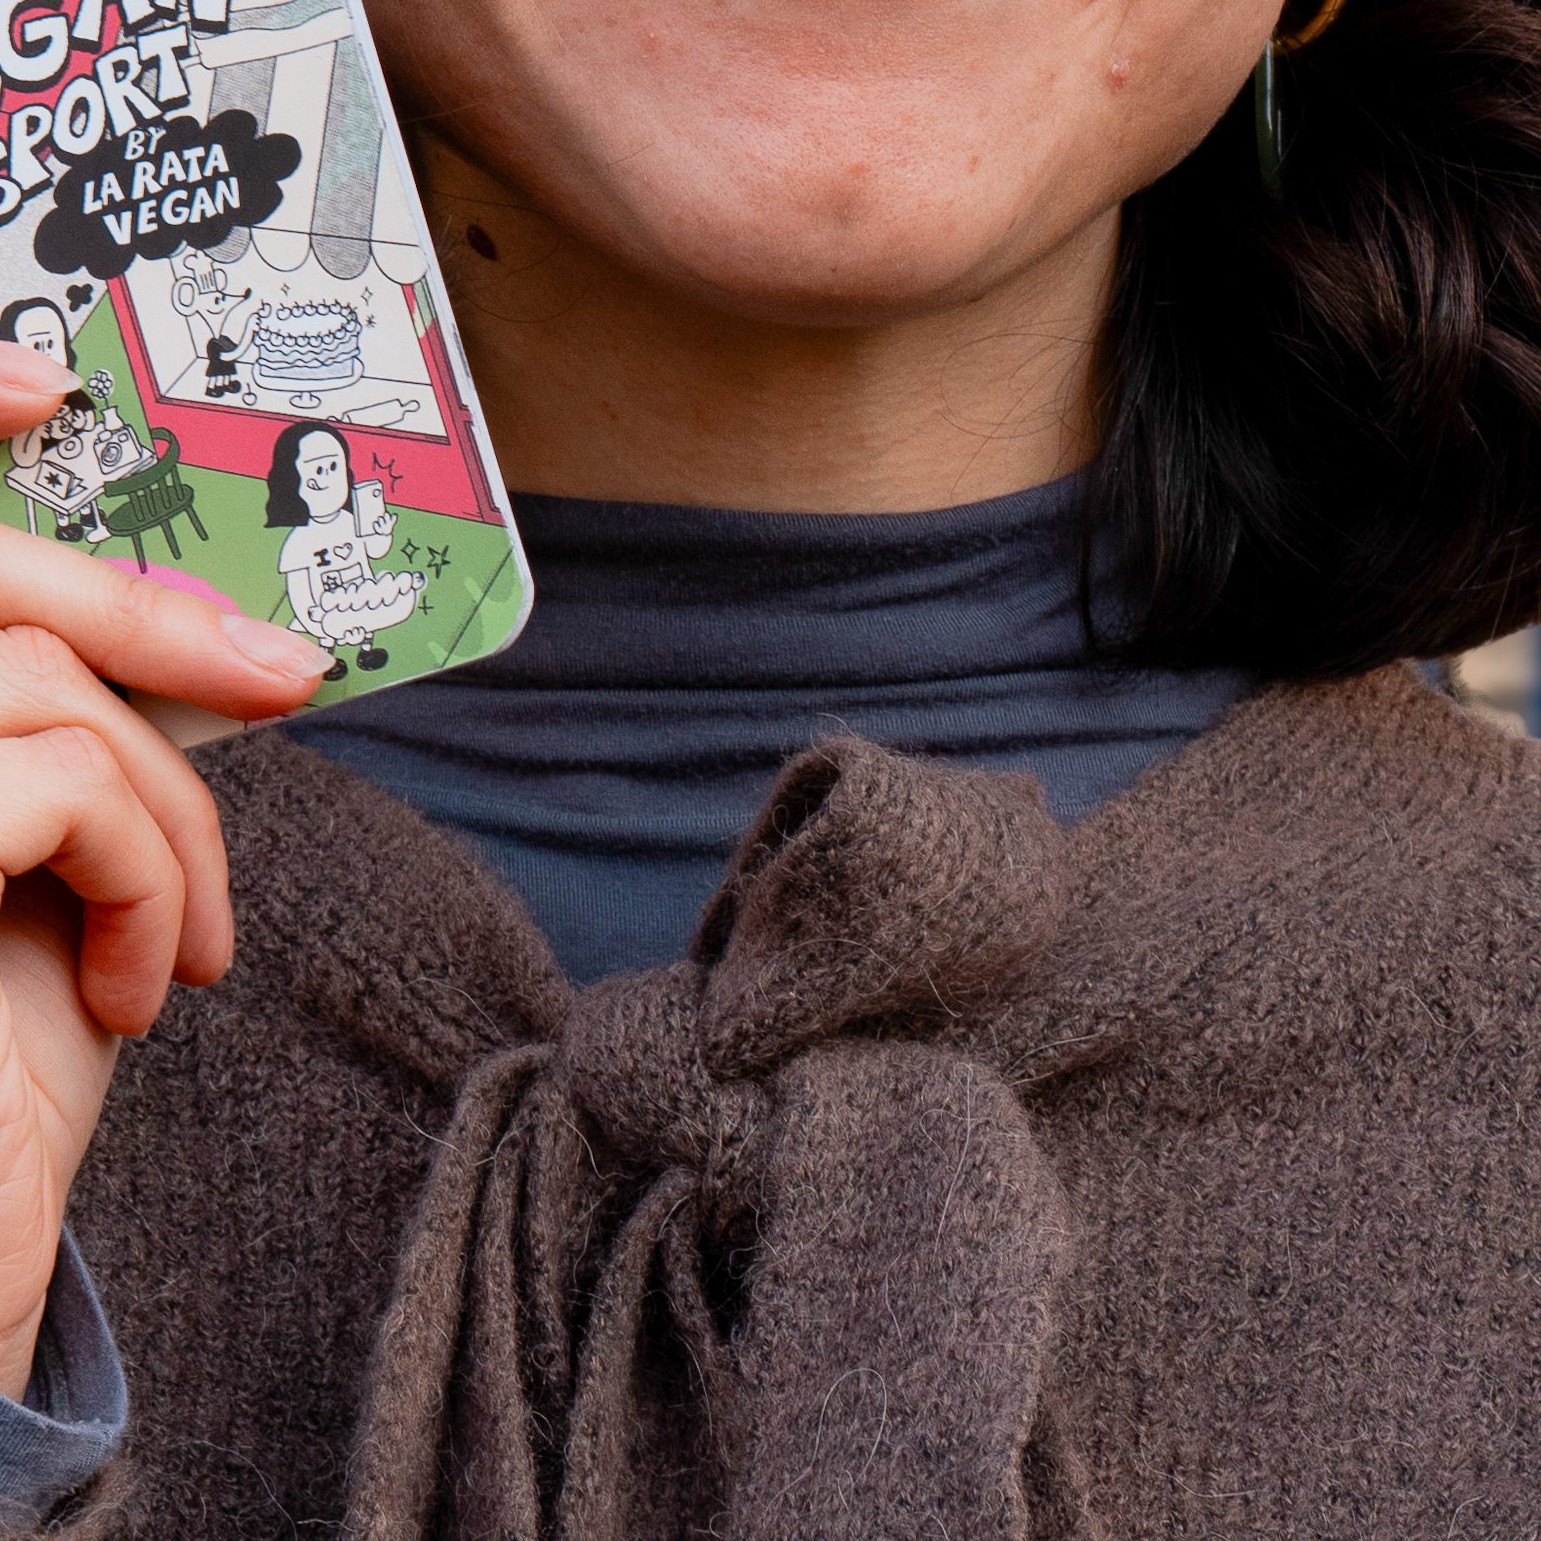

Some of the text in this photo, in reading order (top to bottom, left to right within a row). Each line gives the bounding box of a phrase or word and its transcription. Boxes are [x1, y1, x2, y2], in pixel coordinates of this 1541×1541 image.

[124, 126, 167, 161] BY
[82, 143, 230, 215] LA RATA
[102, 176, 241, 246] VEGAN
